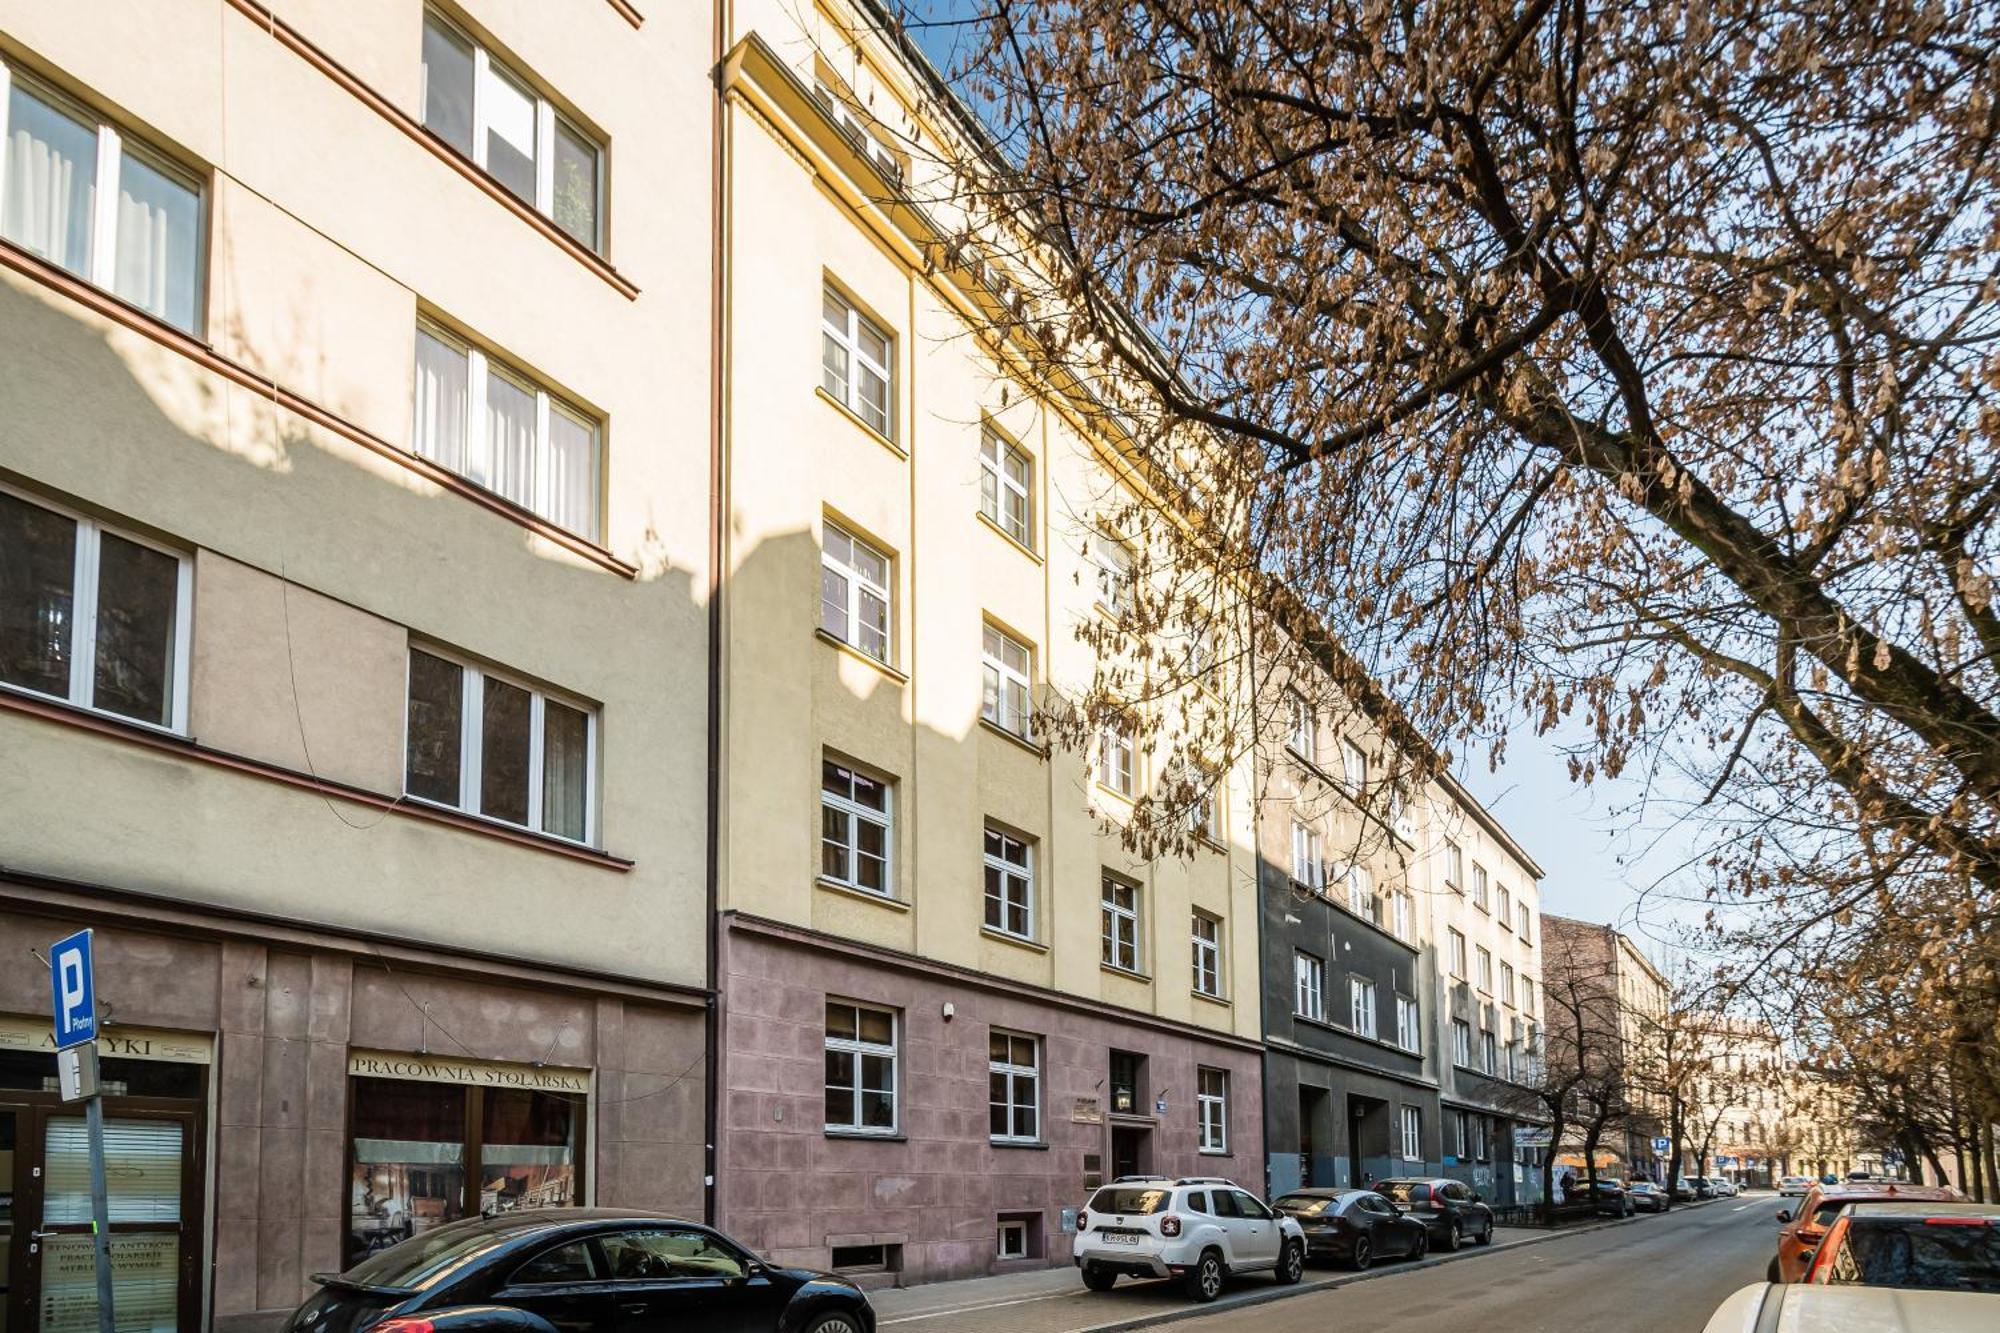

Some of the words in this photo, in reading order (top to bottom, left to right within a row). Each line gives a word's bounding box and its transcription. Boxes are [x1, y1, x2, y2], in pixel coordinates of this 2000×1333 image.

[60, 947, 84, 1034] P
[40, 1033, 151, 1055] AYKI
[355, 1058, 475, 1081] PRACOWNIA
[485, 1070, 583, 1090] STOLARSKA
[1658, 1139, 1667, 1149] P
